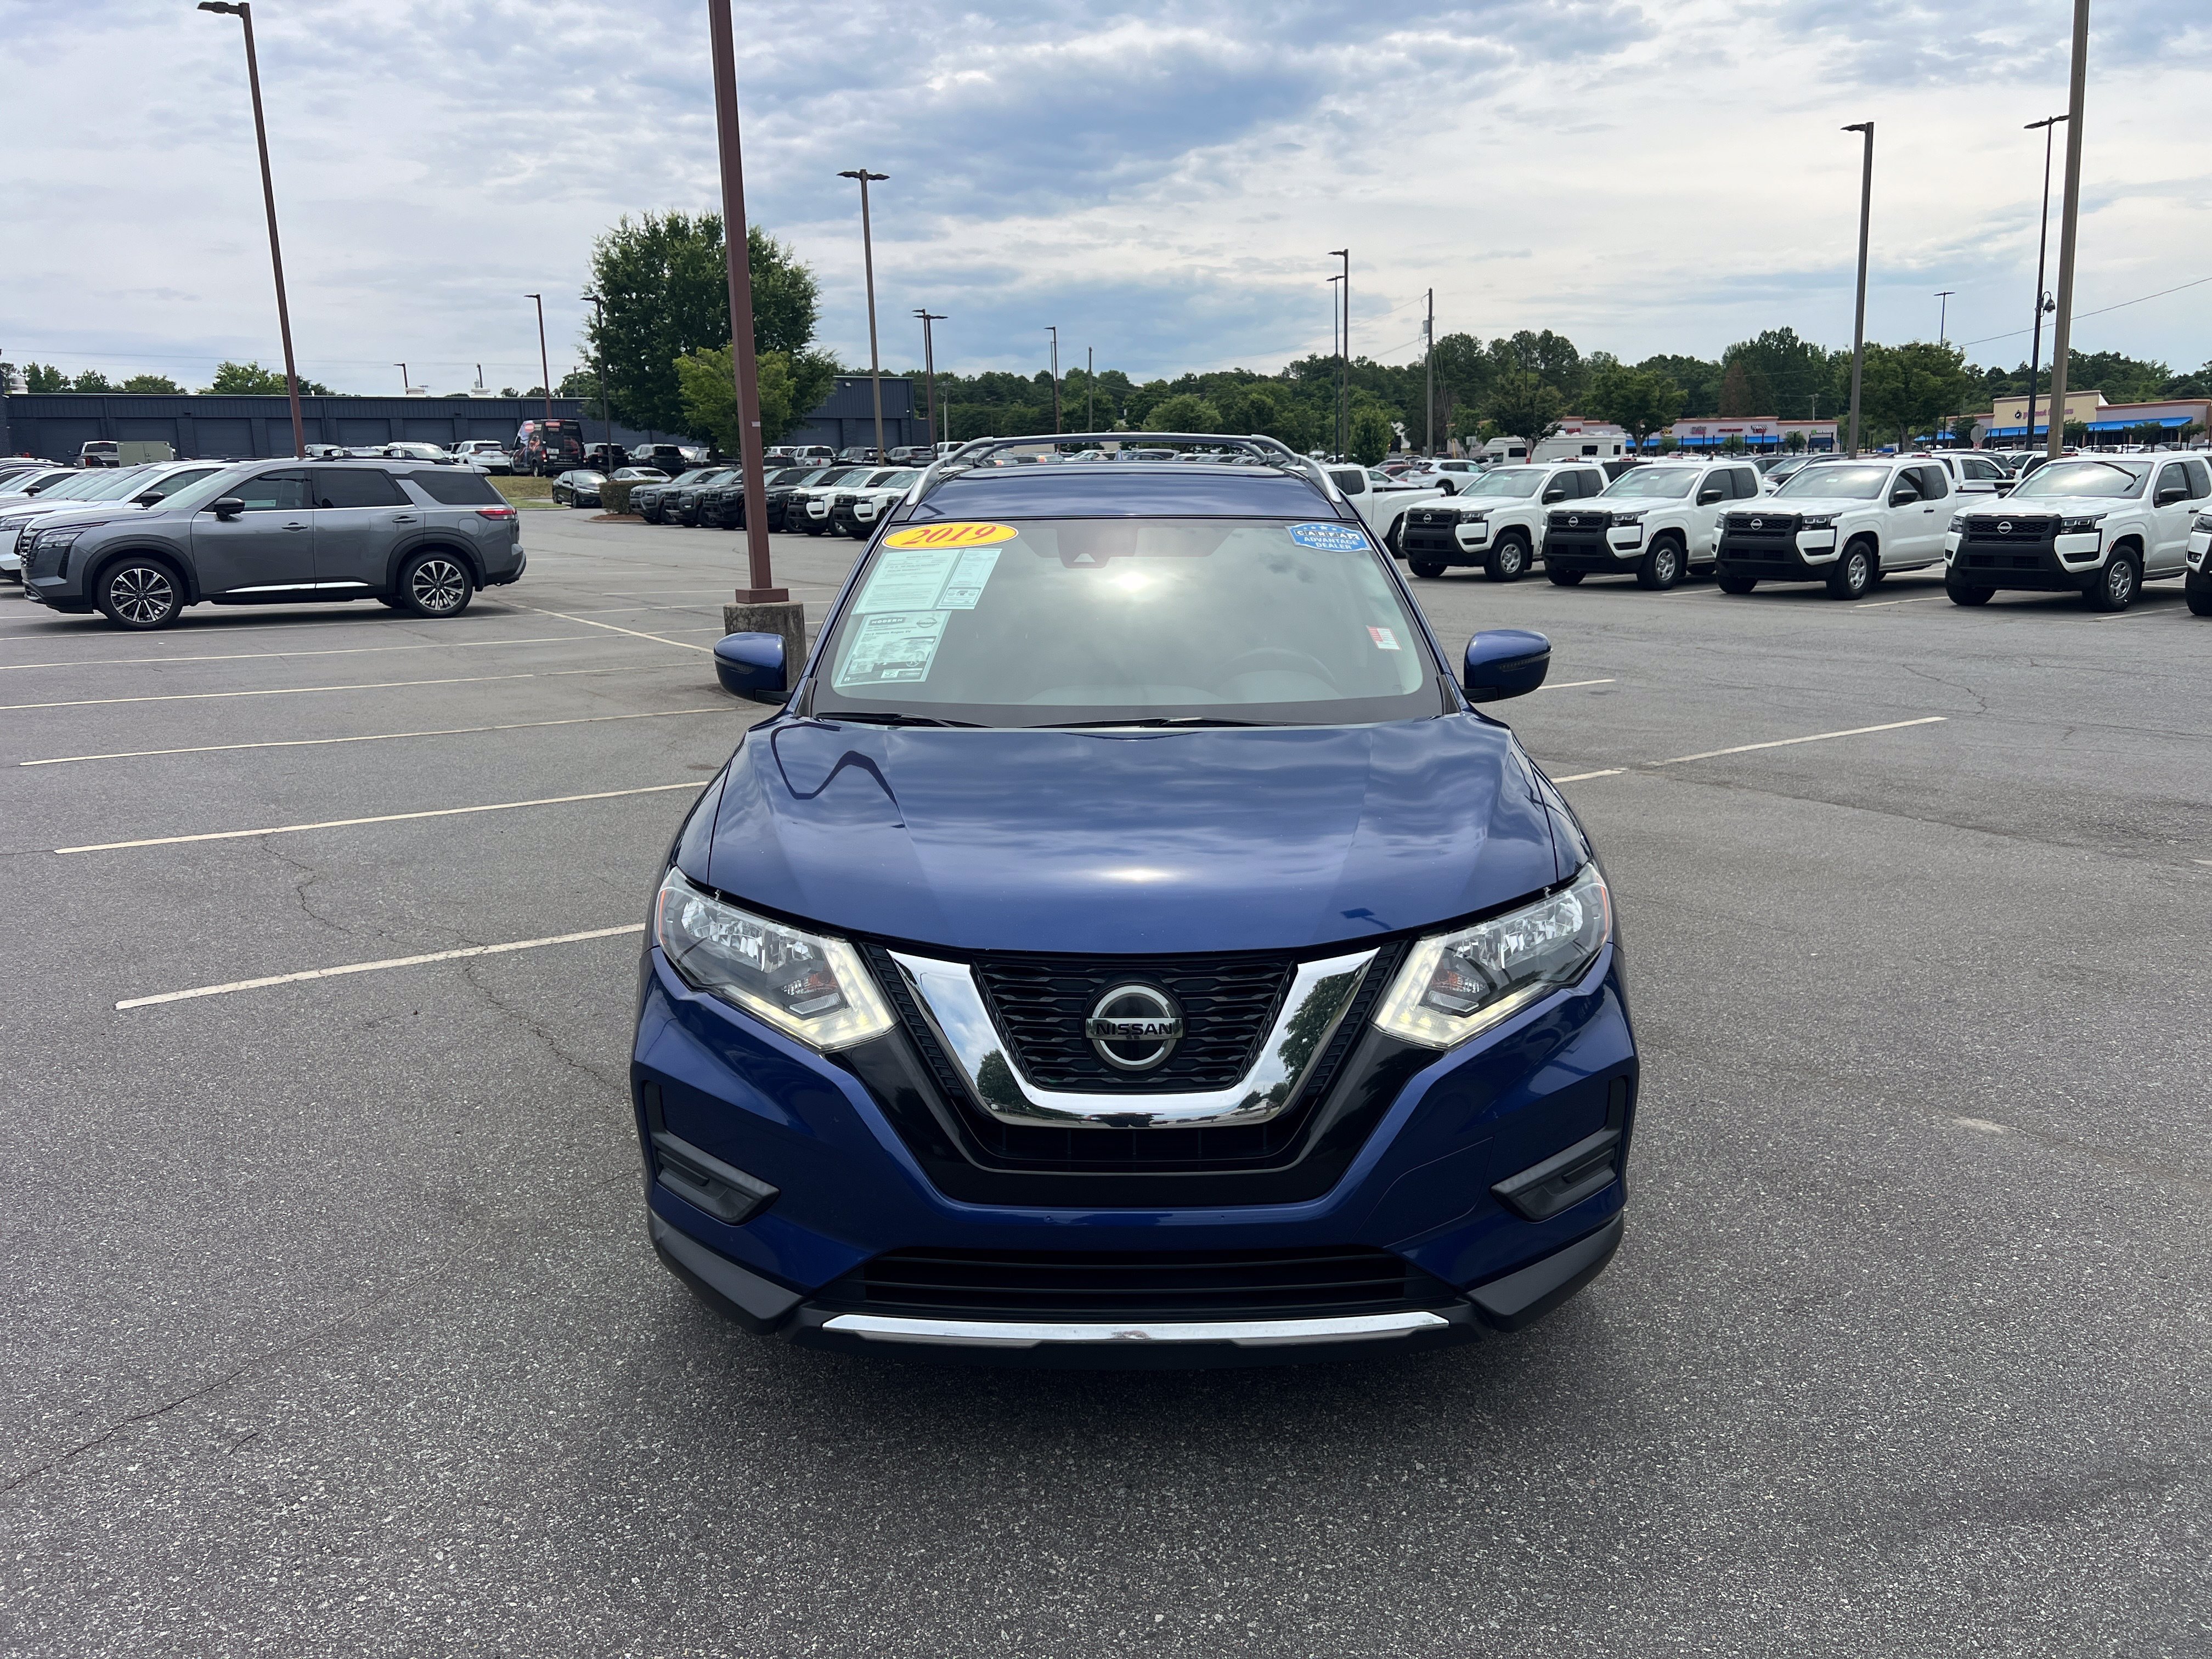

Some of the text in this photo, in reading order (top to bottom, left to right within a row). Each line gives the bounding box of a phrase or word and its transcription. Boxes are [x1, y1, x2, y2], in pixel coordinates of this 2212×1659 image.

[900, 526, 996, 545] 2019
[1297, 531, 1361, 540] CARFAX
[1304, 537, 1359, 545] ADVANTAGE
[1097, 1023, 1172, 1035] NISSAN
